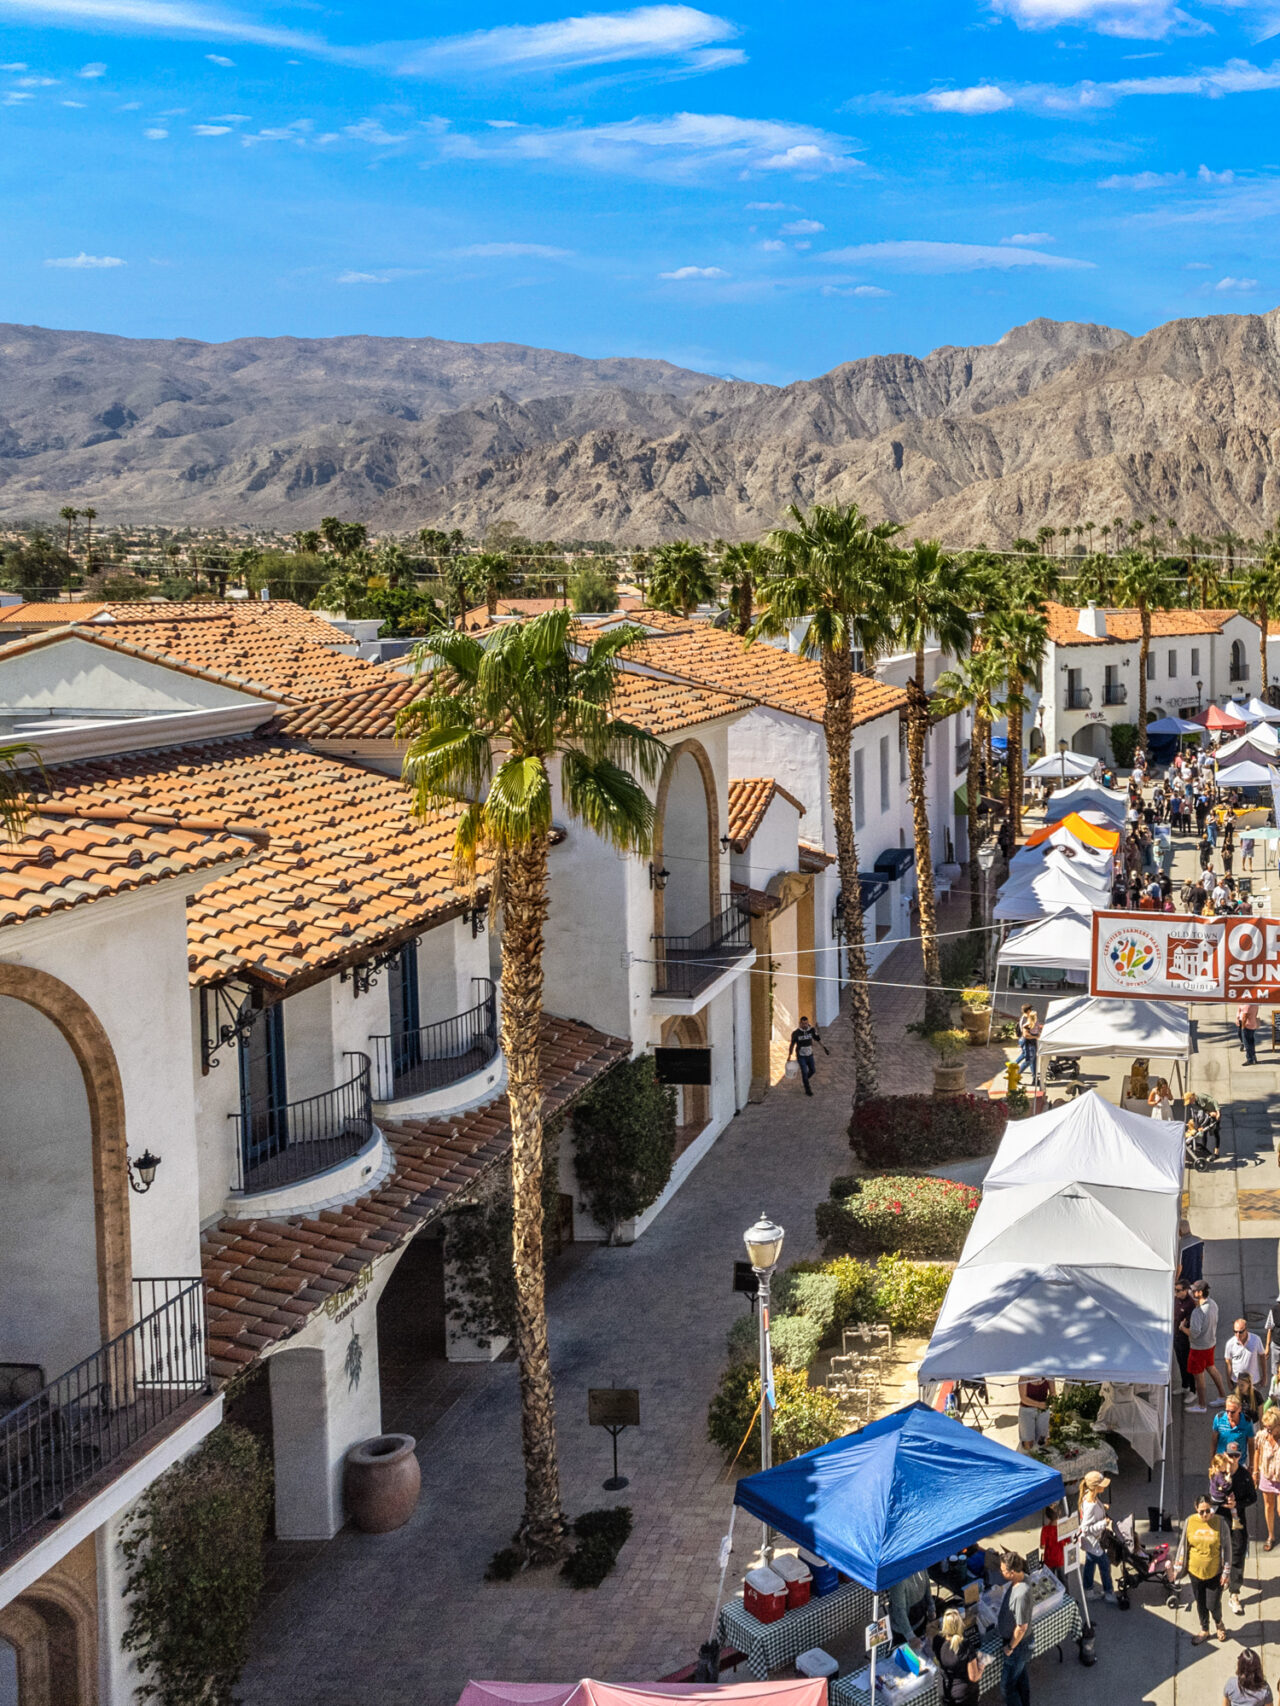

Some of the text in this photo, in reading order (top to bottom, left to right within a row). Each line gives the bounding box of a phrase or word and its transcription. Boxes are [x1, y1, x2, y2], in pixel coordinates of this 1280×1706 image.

[1170, 931, 1218, 940] OLD TOWN
[1103, 928, 1162, 960] CERTIFIED FARMERS MARKET
[1126, 980, 1148, 988] QUINTA
[1170, 981, 1214, 991] La Quinta
[1228, 989, 1269, 999] 8AM
[335, 1289, 369, 1324] COMPANY
